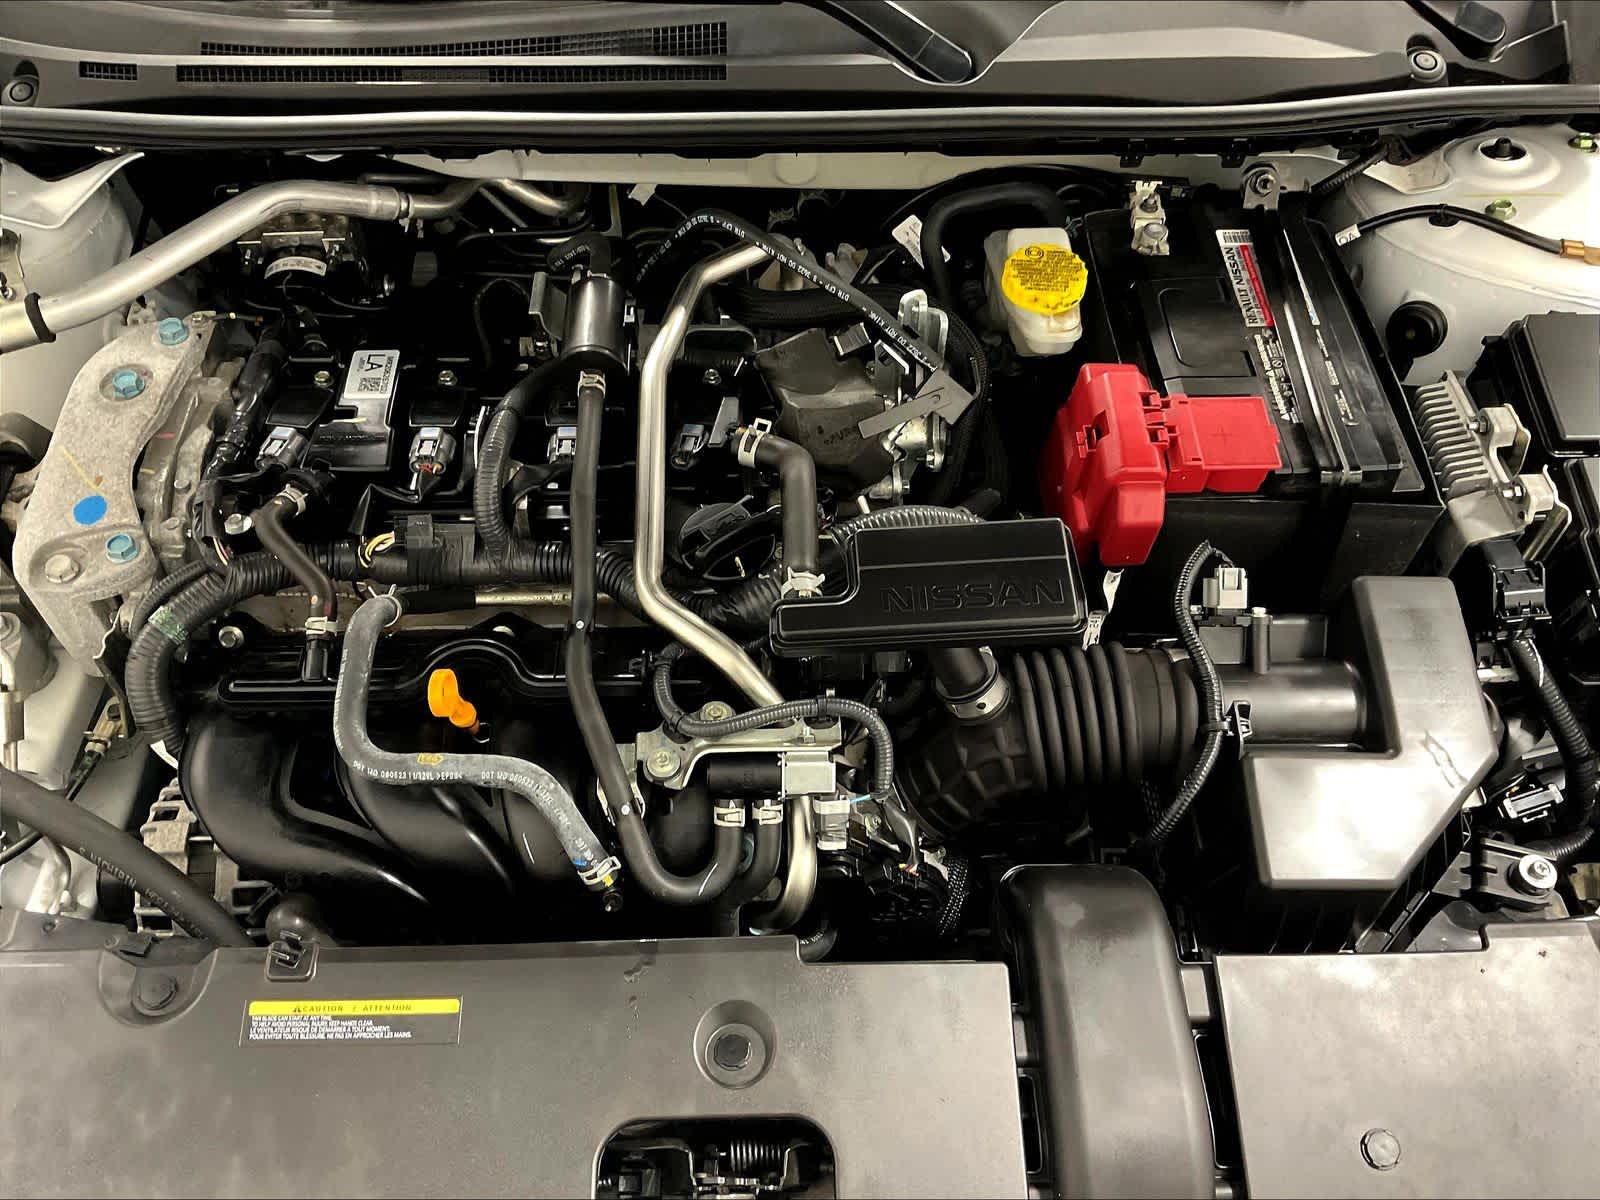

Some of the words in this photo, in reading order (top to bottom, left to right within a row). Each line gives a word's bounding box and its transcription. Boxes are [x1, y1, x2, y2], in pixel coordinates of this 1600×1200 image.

[776, 253, 789, 264] NOT
[1224, 247, 1246, 286] NISSAN
[836, 292, 850, 302] DTR
[1238, 288, 1258, 324] RENAULT
[364, 354, 386, 372] LA
[880, 577, 1065, 614] NISSAN
